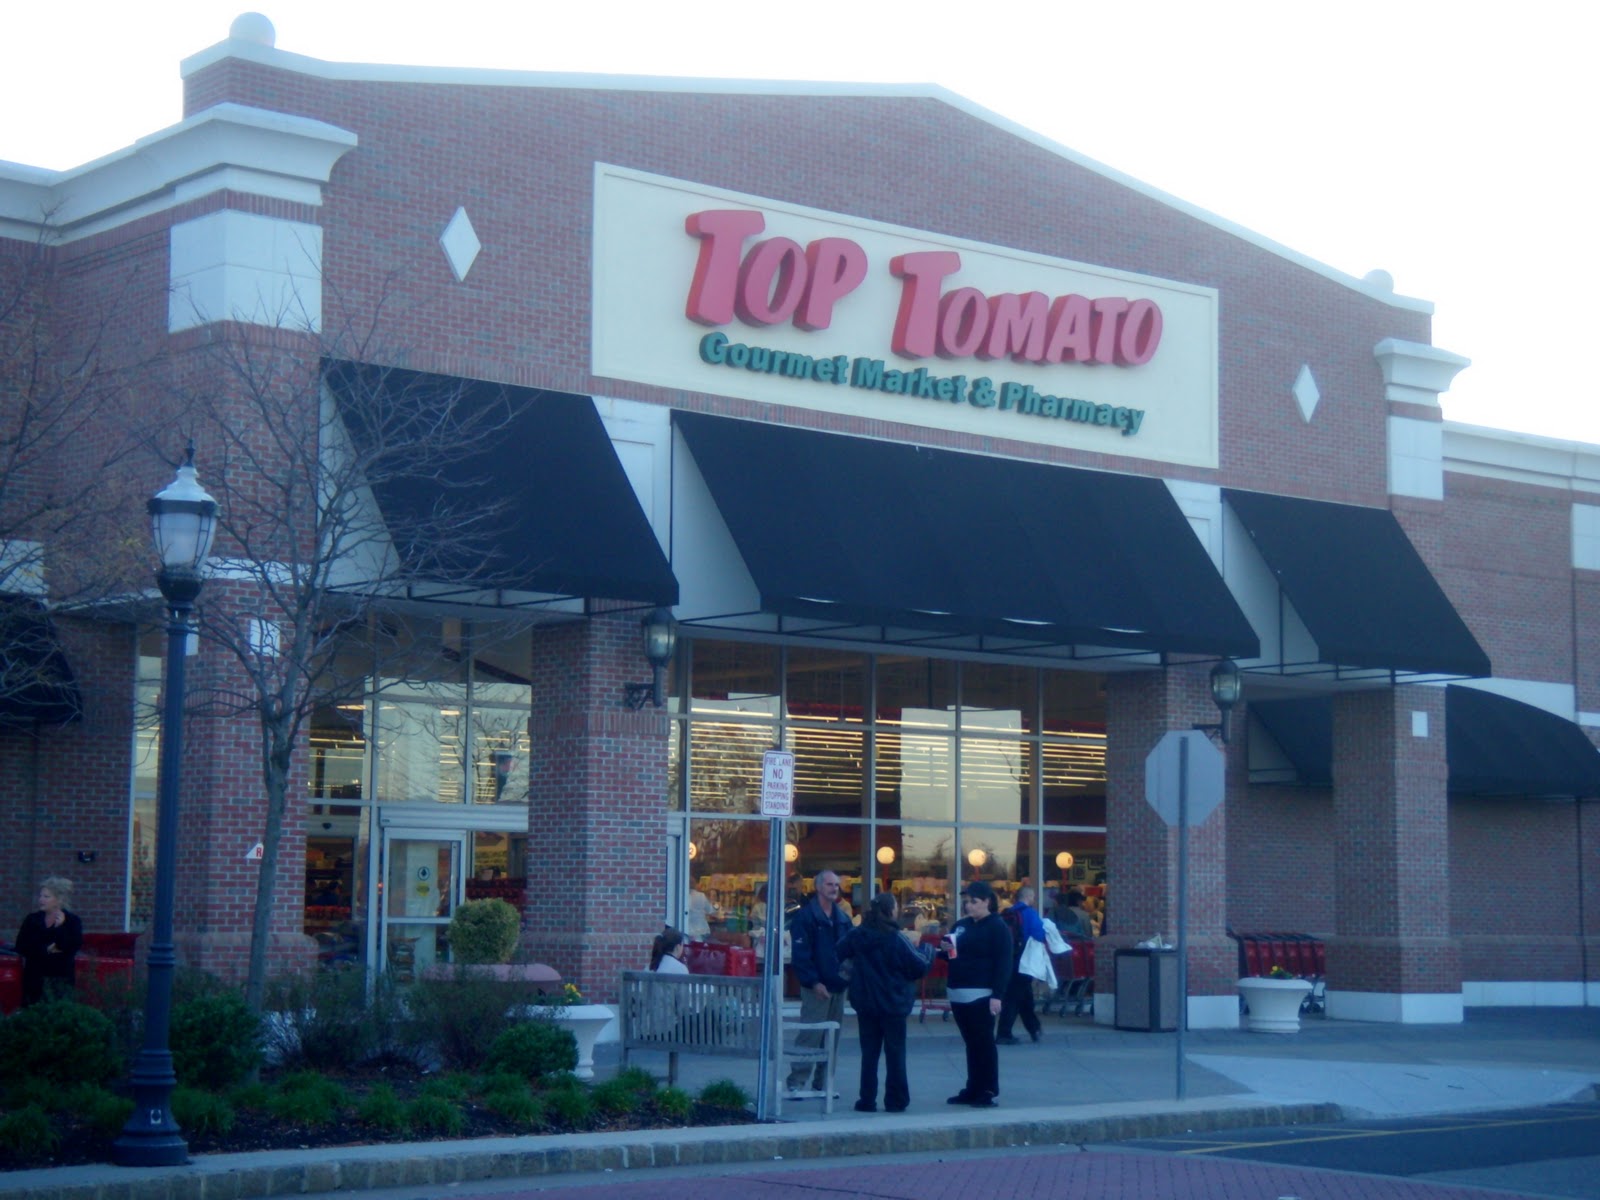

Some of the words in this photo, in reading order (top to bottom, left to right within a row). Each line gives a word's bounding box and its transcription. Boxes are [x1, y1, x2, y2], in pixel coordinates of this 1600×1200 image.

[685, 209, 868, 331] TOP
[889, 251, 1163, 366] TOMATO
[700, 332, 848, 385] Gourmet
[850, 357, 968, 402] Market
[969, 377, 998, 409] &
[999, 380, 1145, 436] Pharmacy
[766, 757, 777, 766] FIRE
[778, 758, 792, 767] LANE
[773, 768, 783, 780] NO
[767, 782, 788, 791] PARKING
[765, 791, 789, 801] STOPPING
[765, 801, 789, 811] STANDING
[256, 846, 263, 858] R
